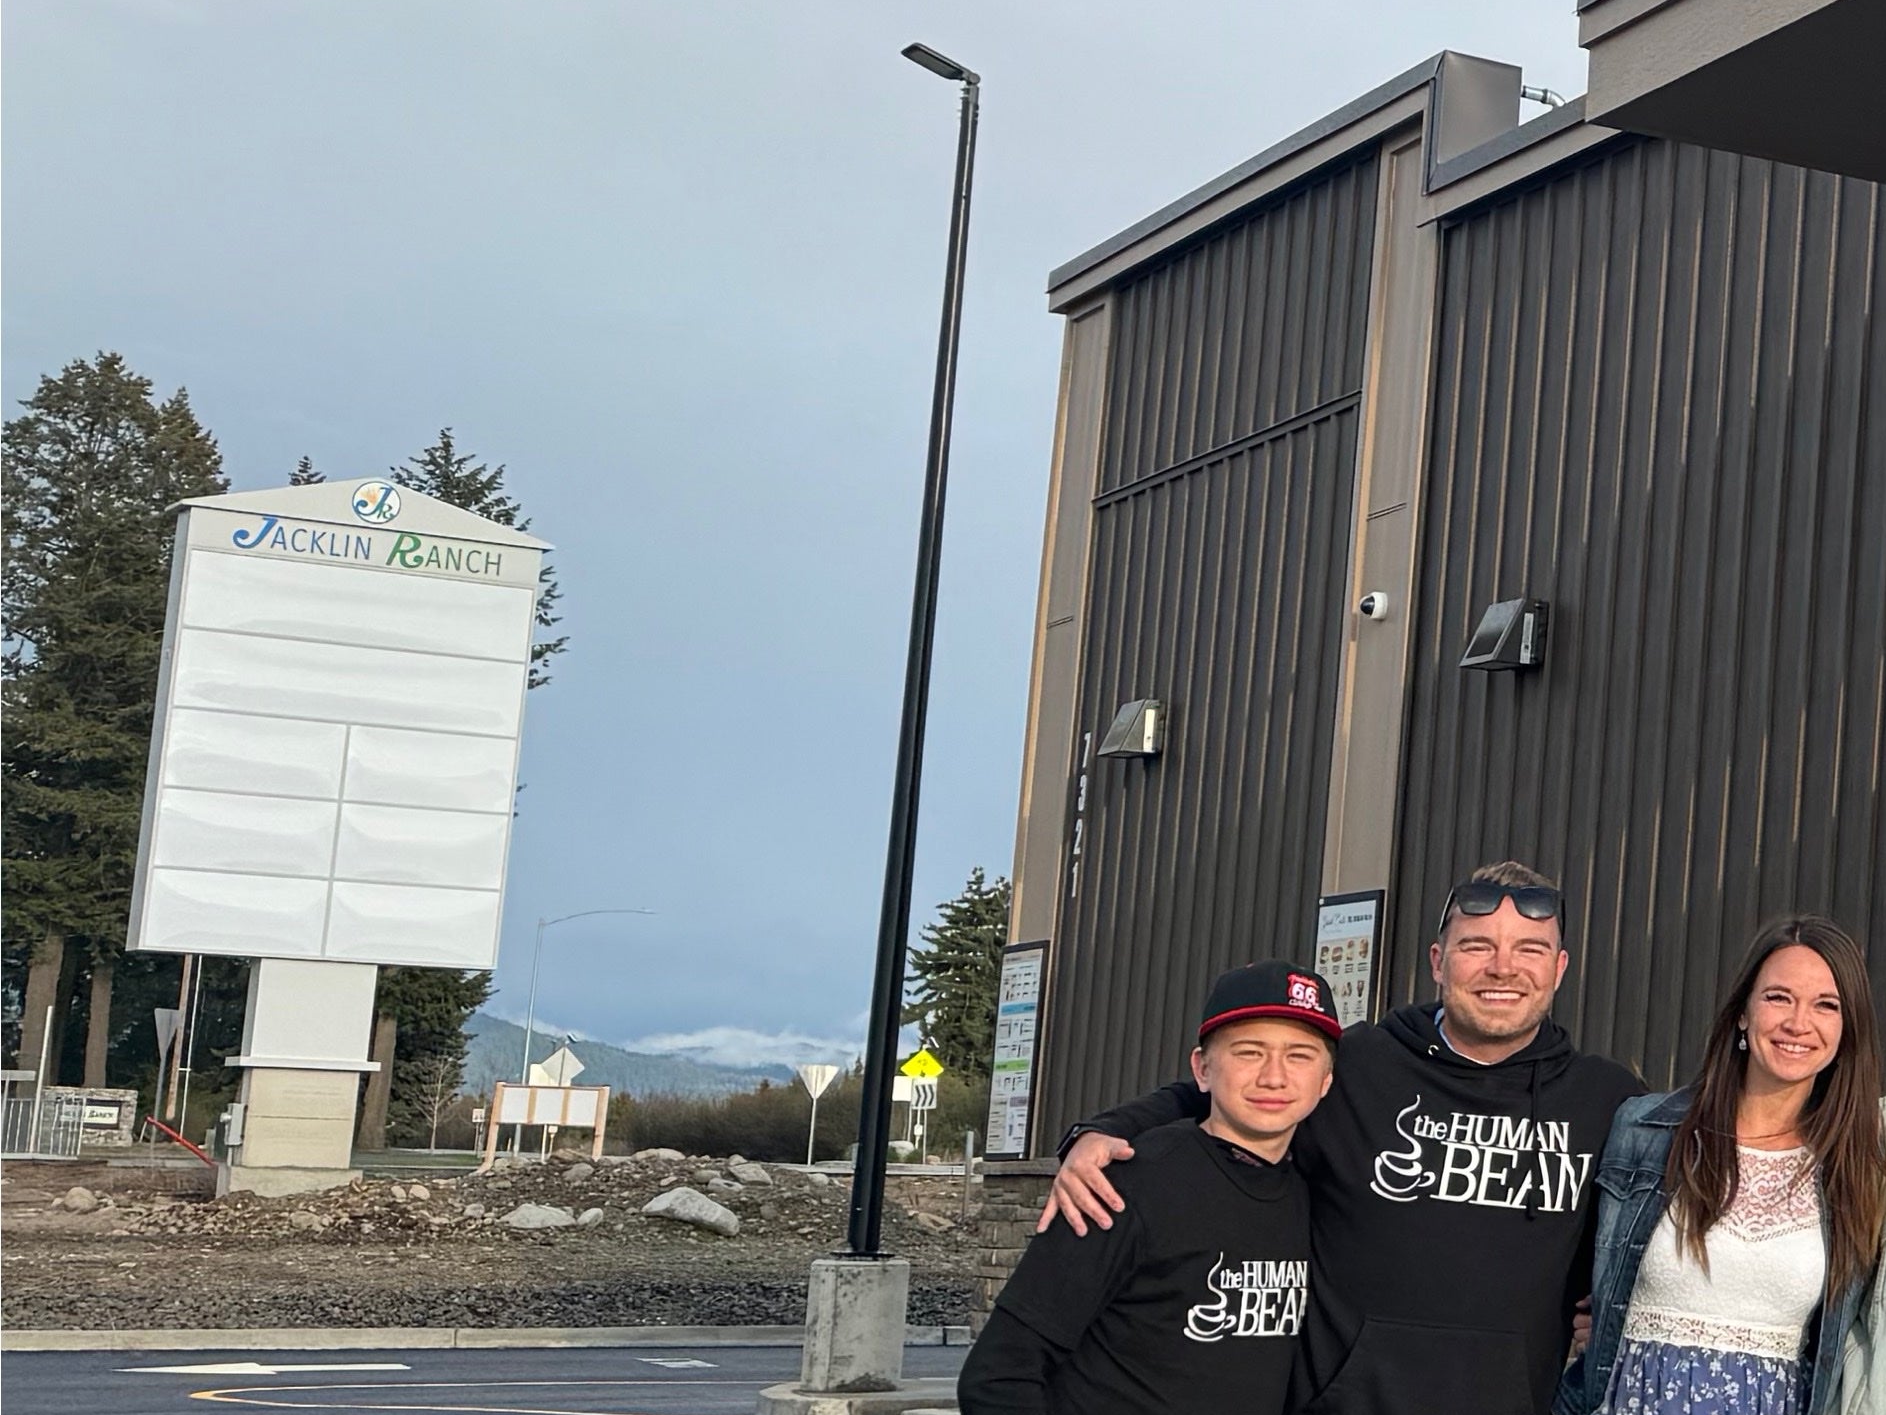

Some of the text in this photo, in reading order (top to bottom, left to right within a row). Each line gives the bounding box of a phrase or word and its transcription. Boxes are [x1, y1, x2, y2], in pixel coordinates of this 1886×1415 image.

[232, 515, 502, 576] JACKLIN RANCH
[1412, 1112, 1570, 1153] the HUMAN
[1429, 1140, 1594, 1212] BEAN
[1220, 1260, 1308, 1289] the HUMAN
